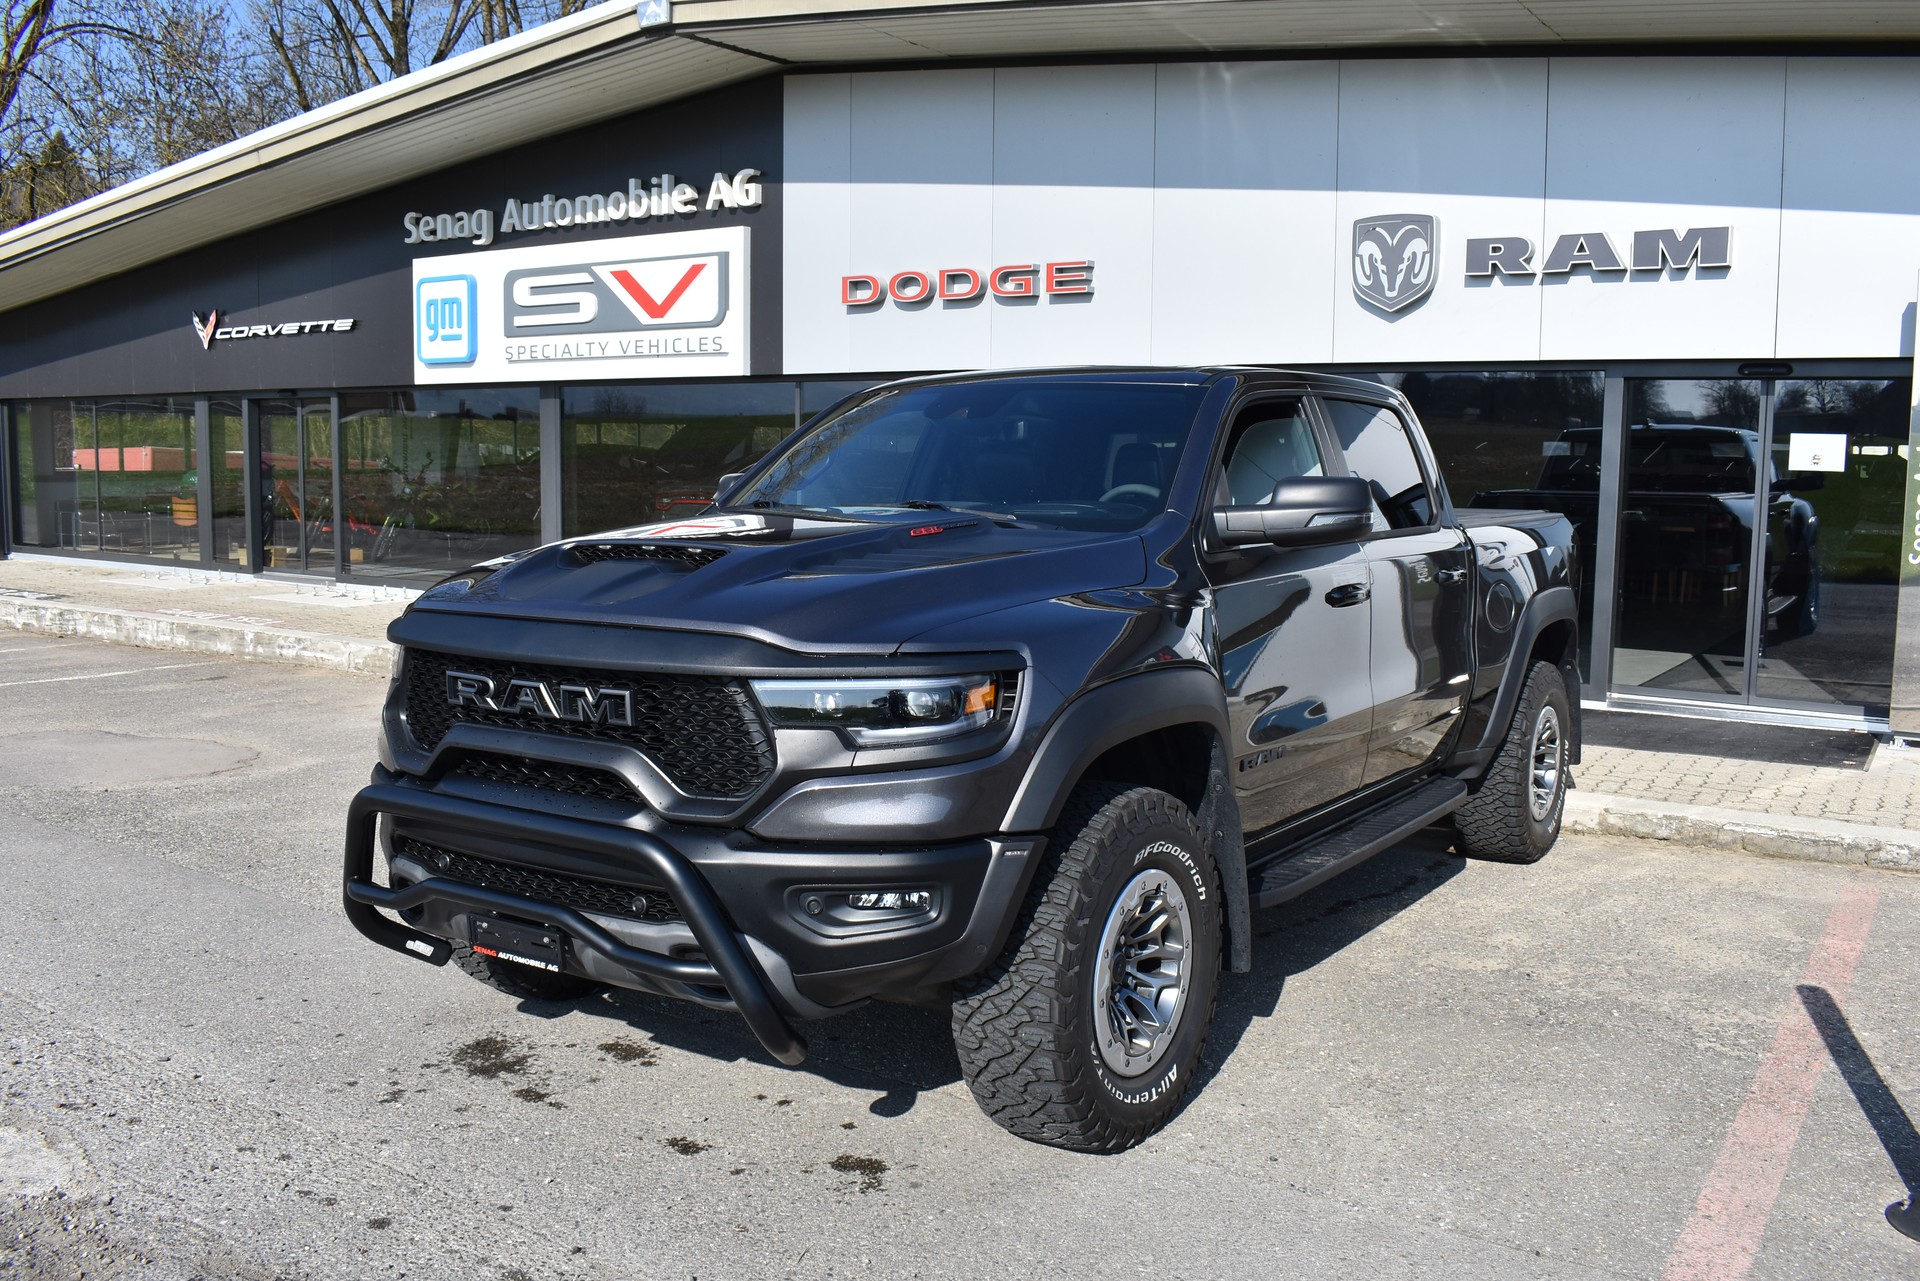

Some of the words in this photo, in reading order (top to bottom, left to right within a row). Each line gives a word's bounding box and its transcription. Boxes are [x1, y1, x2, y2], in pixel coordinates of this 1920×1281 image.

[404, 209, 493, 246] Senag
[500, 173, 698, 233] Automobile
[705, 169, 762, 211] AG
[1464, 224, 1733, 276] RAM
[841, 260, 1095, 306] DODGE
[215, 318, 354, 340] CORVETTE
[425, 297, 462, 341] gm
[505, 341, 609, 360] SPECIALTY
[619, 336, 723, 355] VEHICLES
[446, 670, 633, 726] RAM
[1239, 745, 1286, 772] RAM
[1133, 841, 1206, 900] BFGoodrich
[473, 945, 497, 957] SENAG
[497, 952, 546, 969] AUTOMOBILE
[546, 964, 559, 972] AG
[1103, 1063, 1178, 1104] All-Terrain
